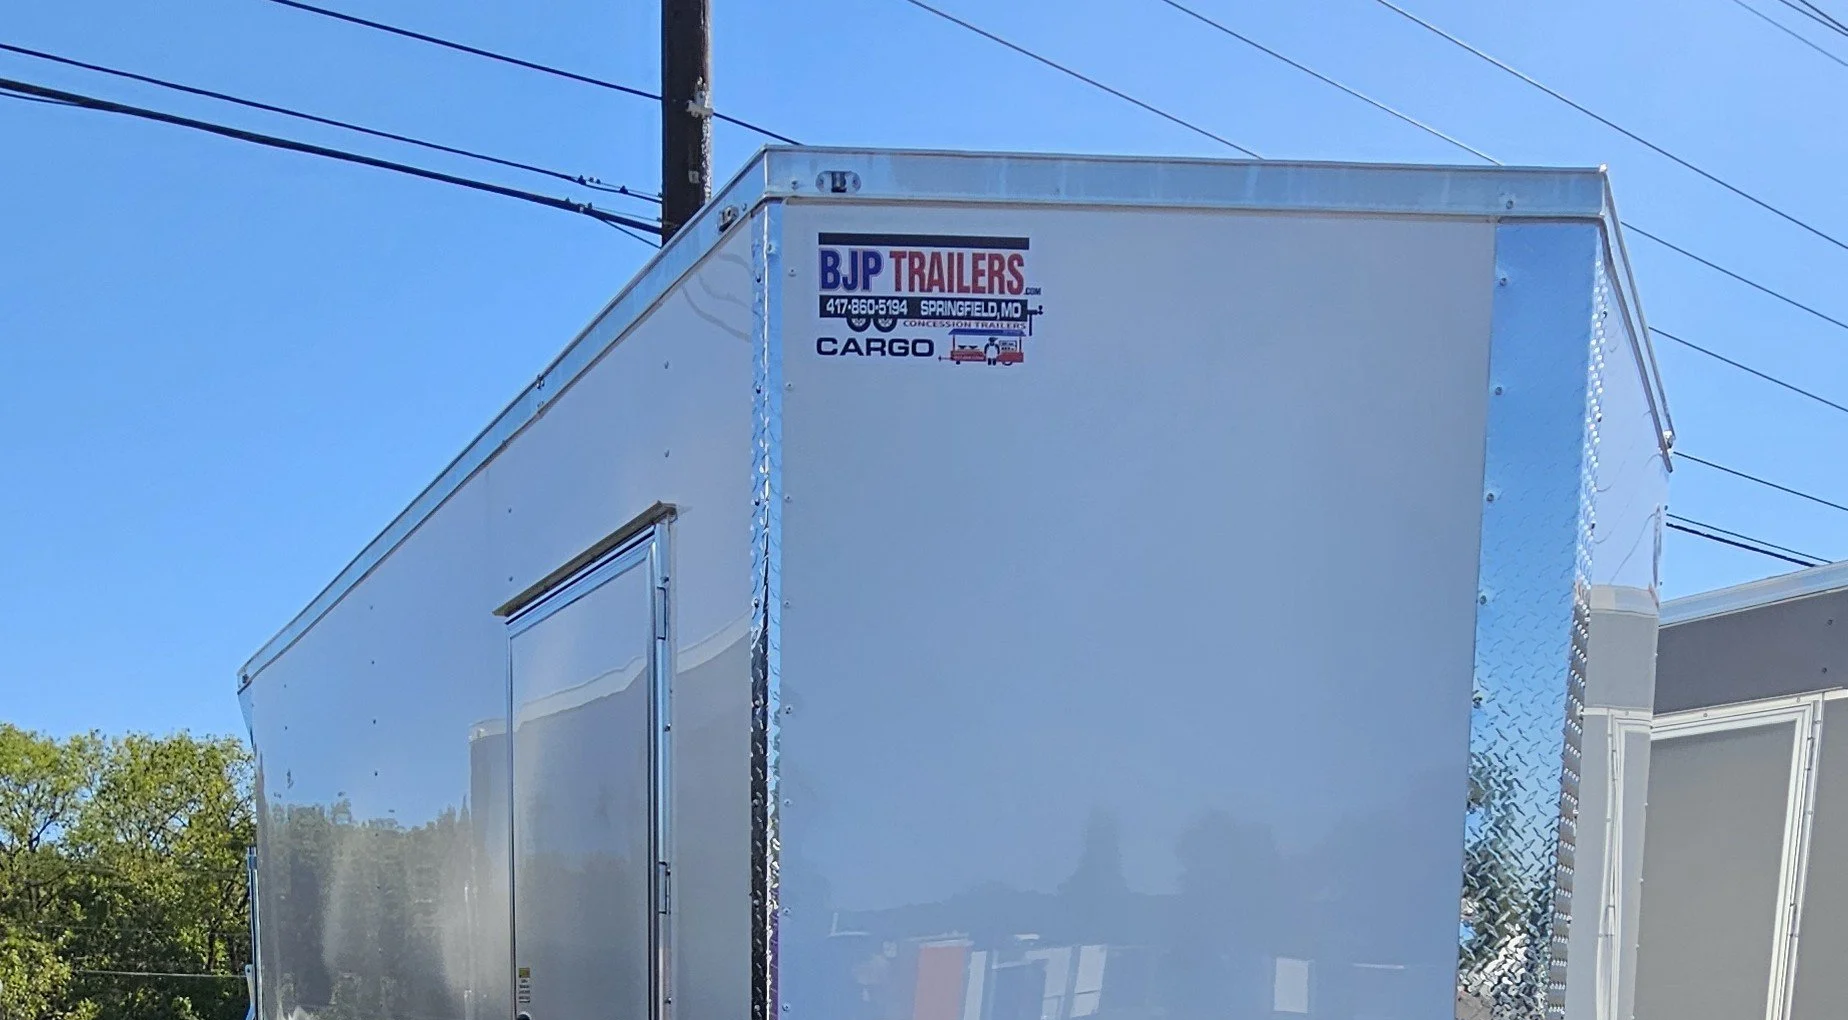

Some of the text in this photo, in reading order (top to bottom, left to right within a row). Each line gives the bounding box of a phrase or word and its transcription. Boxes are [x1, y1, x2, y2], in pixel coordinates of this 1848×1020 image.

[819, 248, 884, 292] BJP
[889, 250, 1025, 296] TRAILERS
[903, 320, 1026, 330] CONCESSION TRAILERS
[816, 337, 934, 357] CARGO
